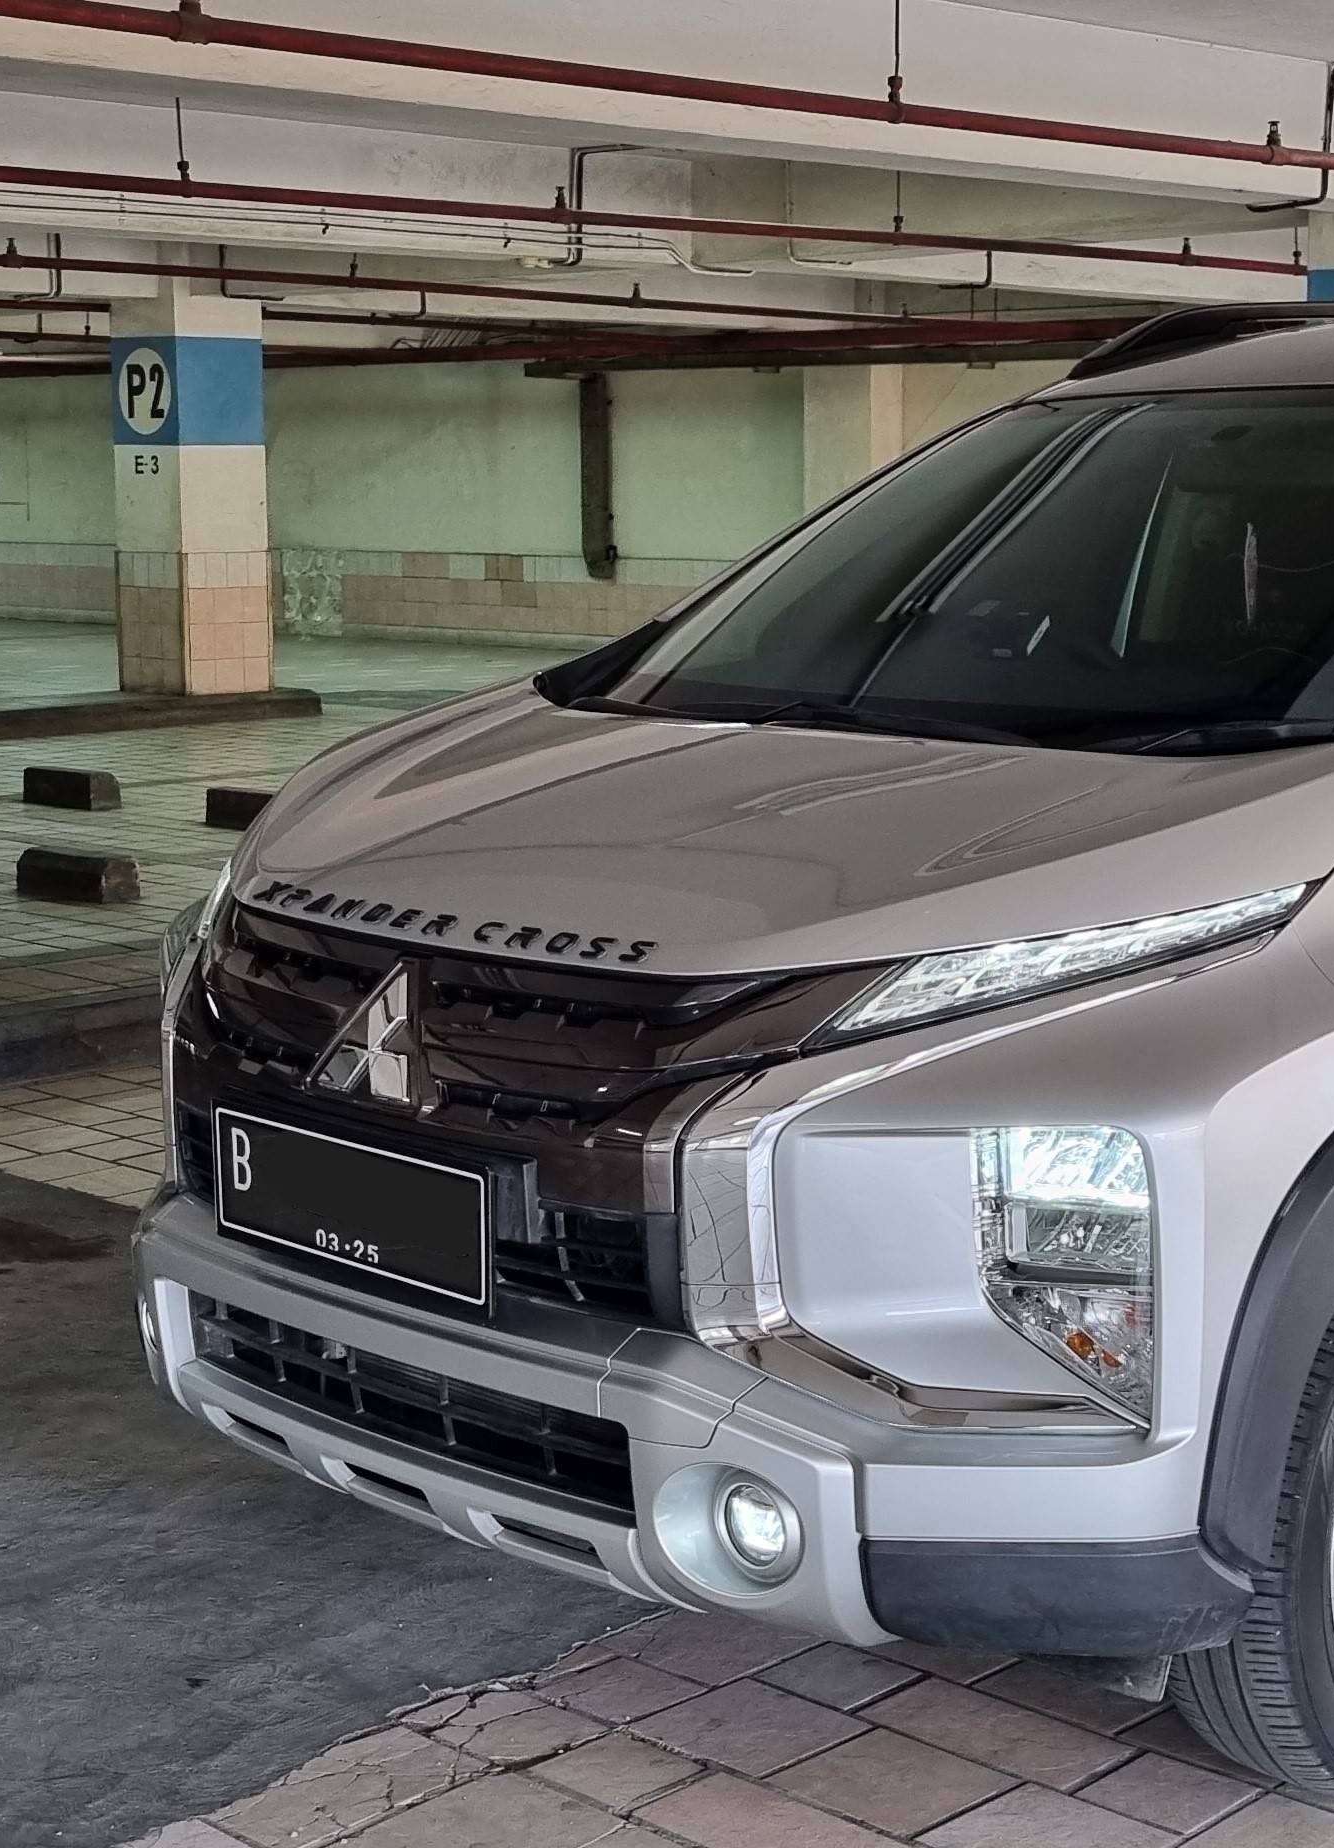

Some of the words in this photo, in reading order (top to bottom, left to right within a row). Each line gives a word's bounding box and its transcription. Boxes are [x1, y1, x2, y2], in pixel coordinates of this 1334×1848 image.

[126, 363, 165, 419] P2
[134, 455, 160, 475] E-3
[253, 881, 459, 937] XPANDER
[474, 921, 660, 963] CROSS
[231, 1127, 253, 1192] B
